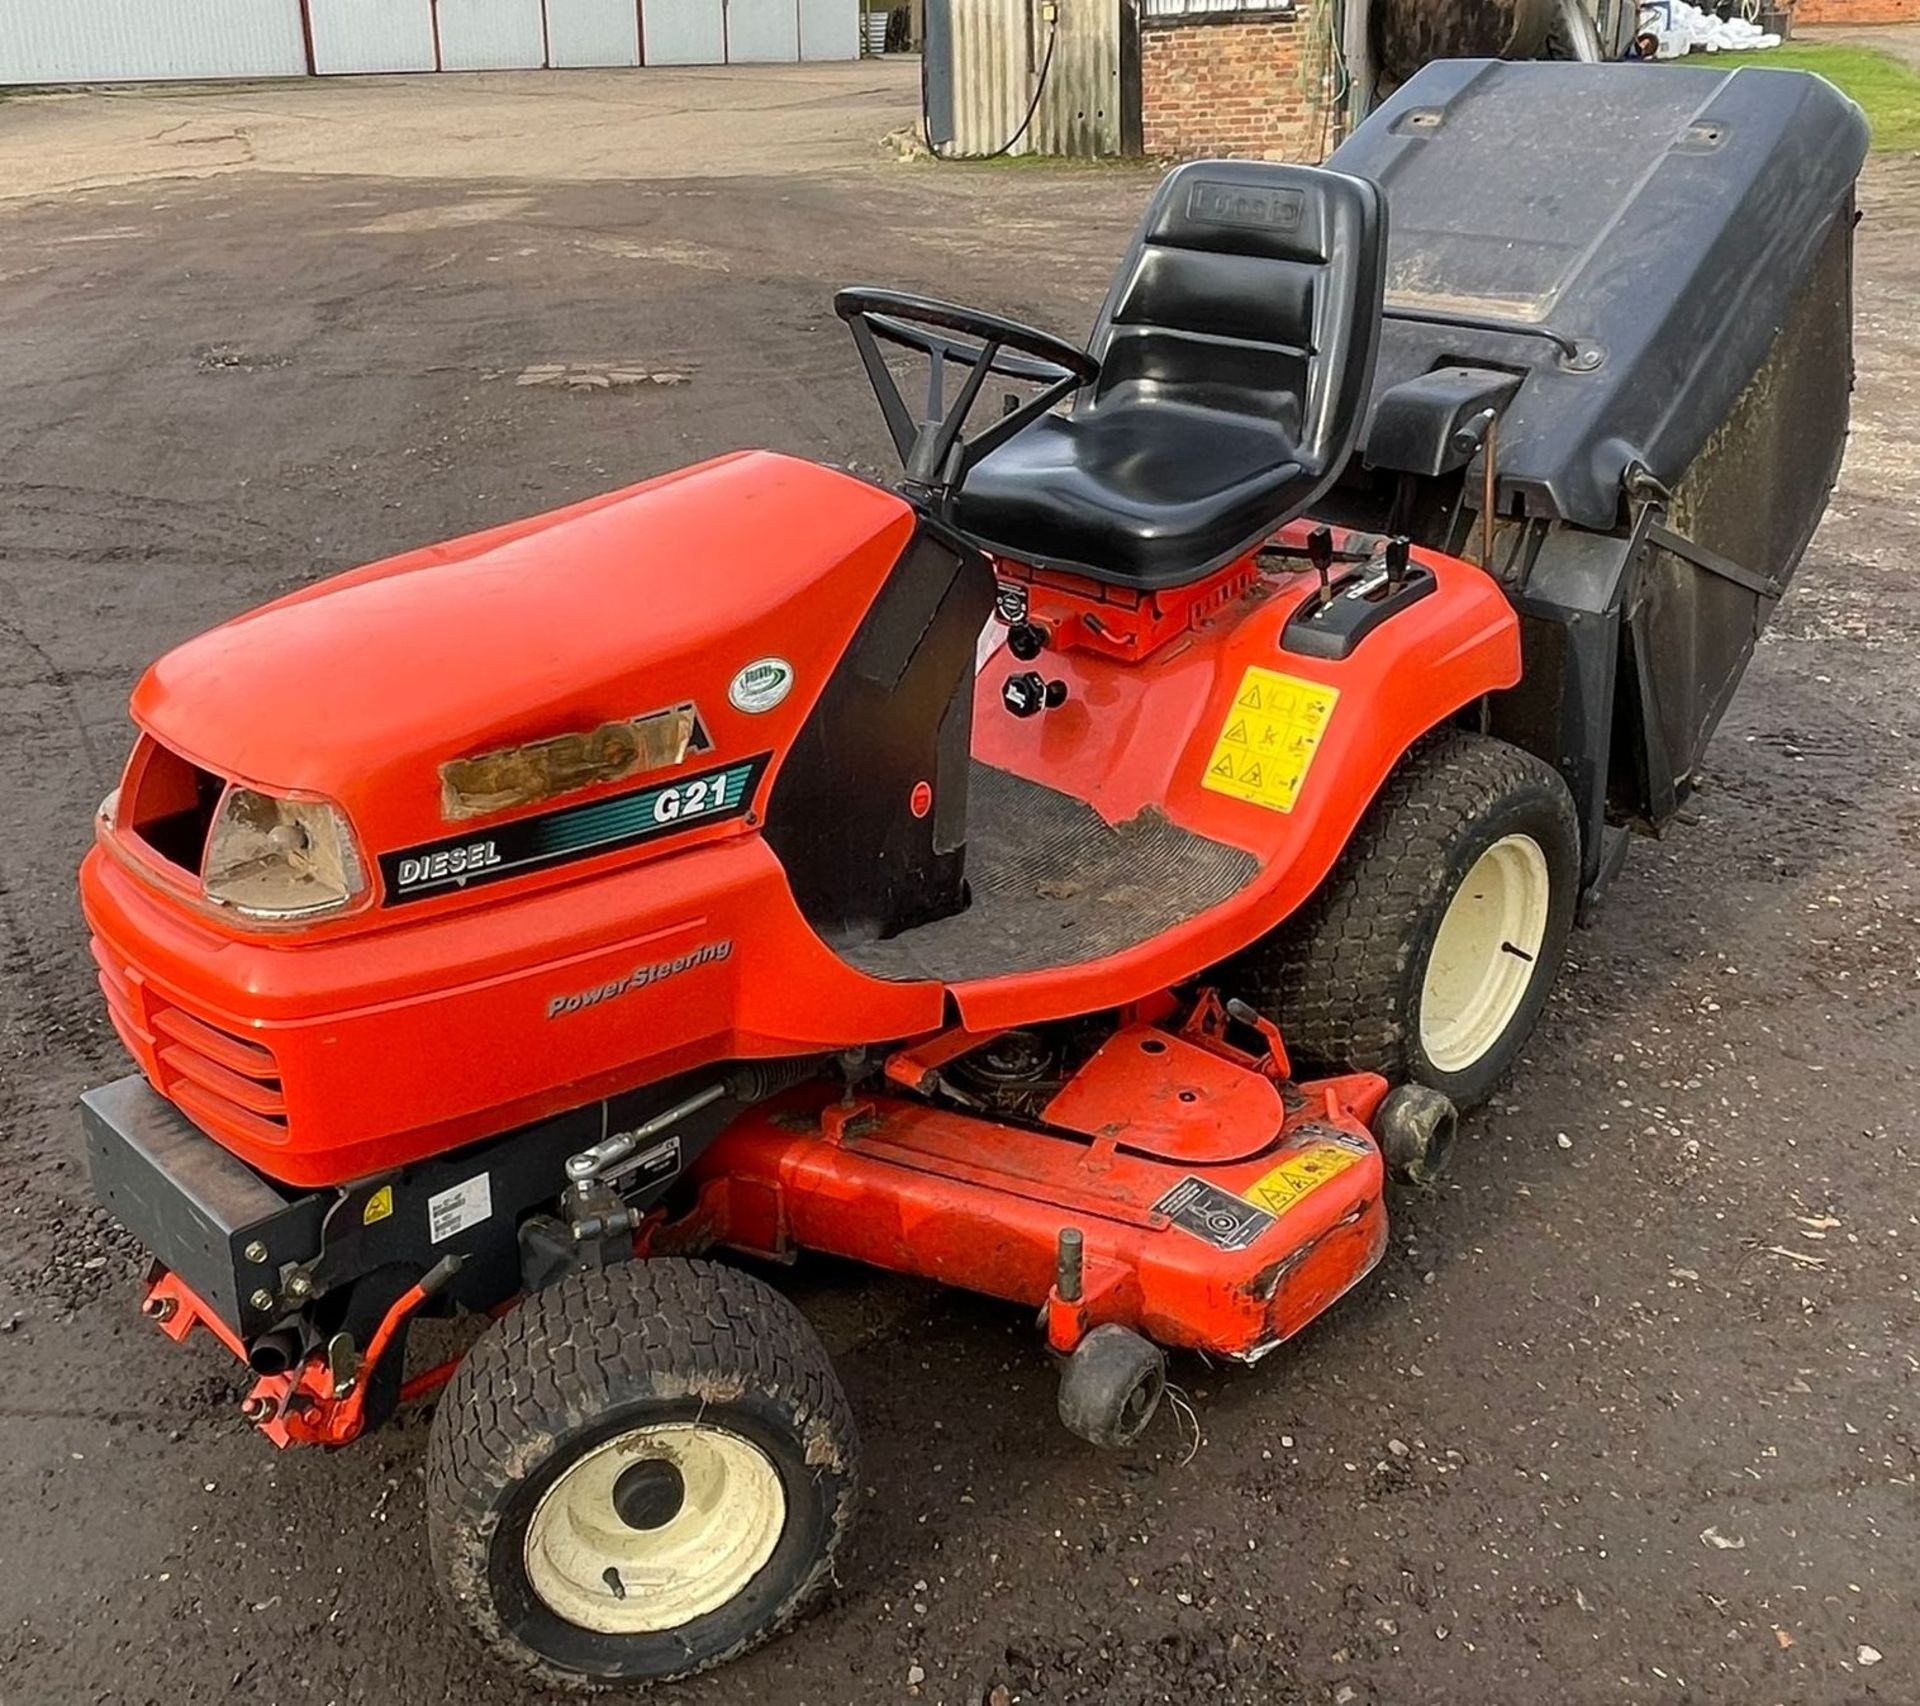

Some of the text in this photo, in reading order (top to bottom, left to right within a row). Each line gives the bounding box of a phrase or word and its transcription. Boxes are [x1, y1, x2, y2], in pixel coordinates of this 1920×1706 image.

[653, 774, 728, 823] G21
[398, 840, 502, 886] DIESEL
[547, 940, 733, 1017] PowerSteering
